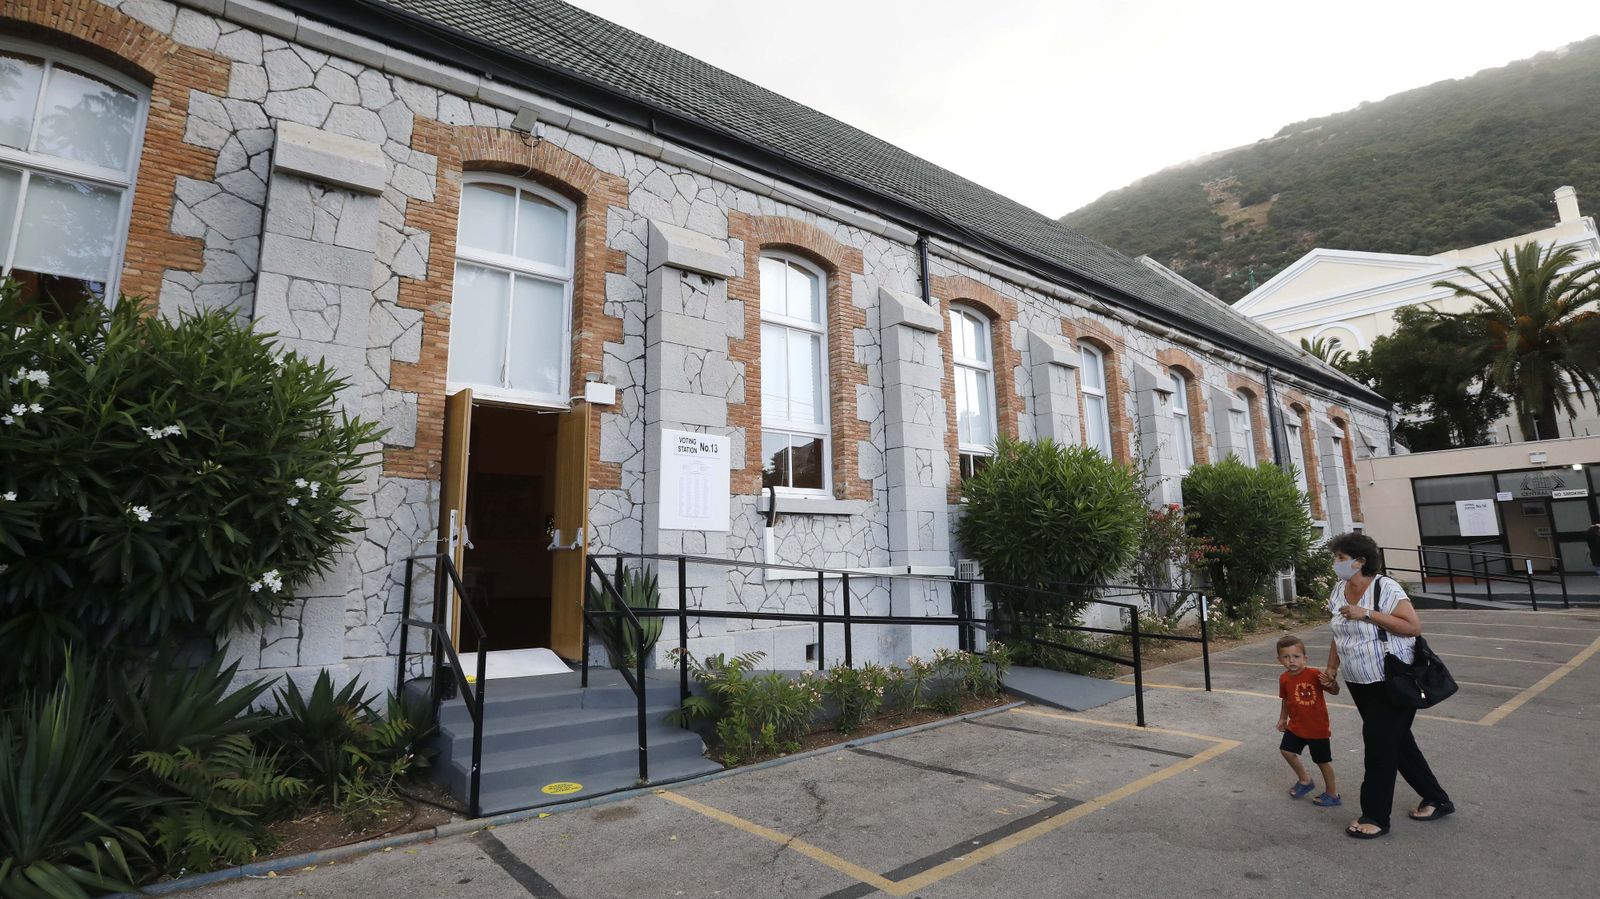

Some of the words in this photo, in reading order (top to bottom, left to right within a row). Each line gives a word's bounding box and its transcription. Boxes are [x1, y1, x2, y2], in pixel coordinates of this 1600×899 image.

[679, 437, 697, 445] VOTING
[678, 446, 697, 454] STATION
[700, 442, 719, 454] No.13
